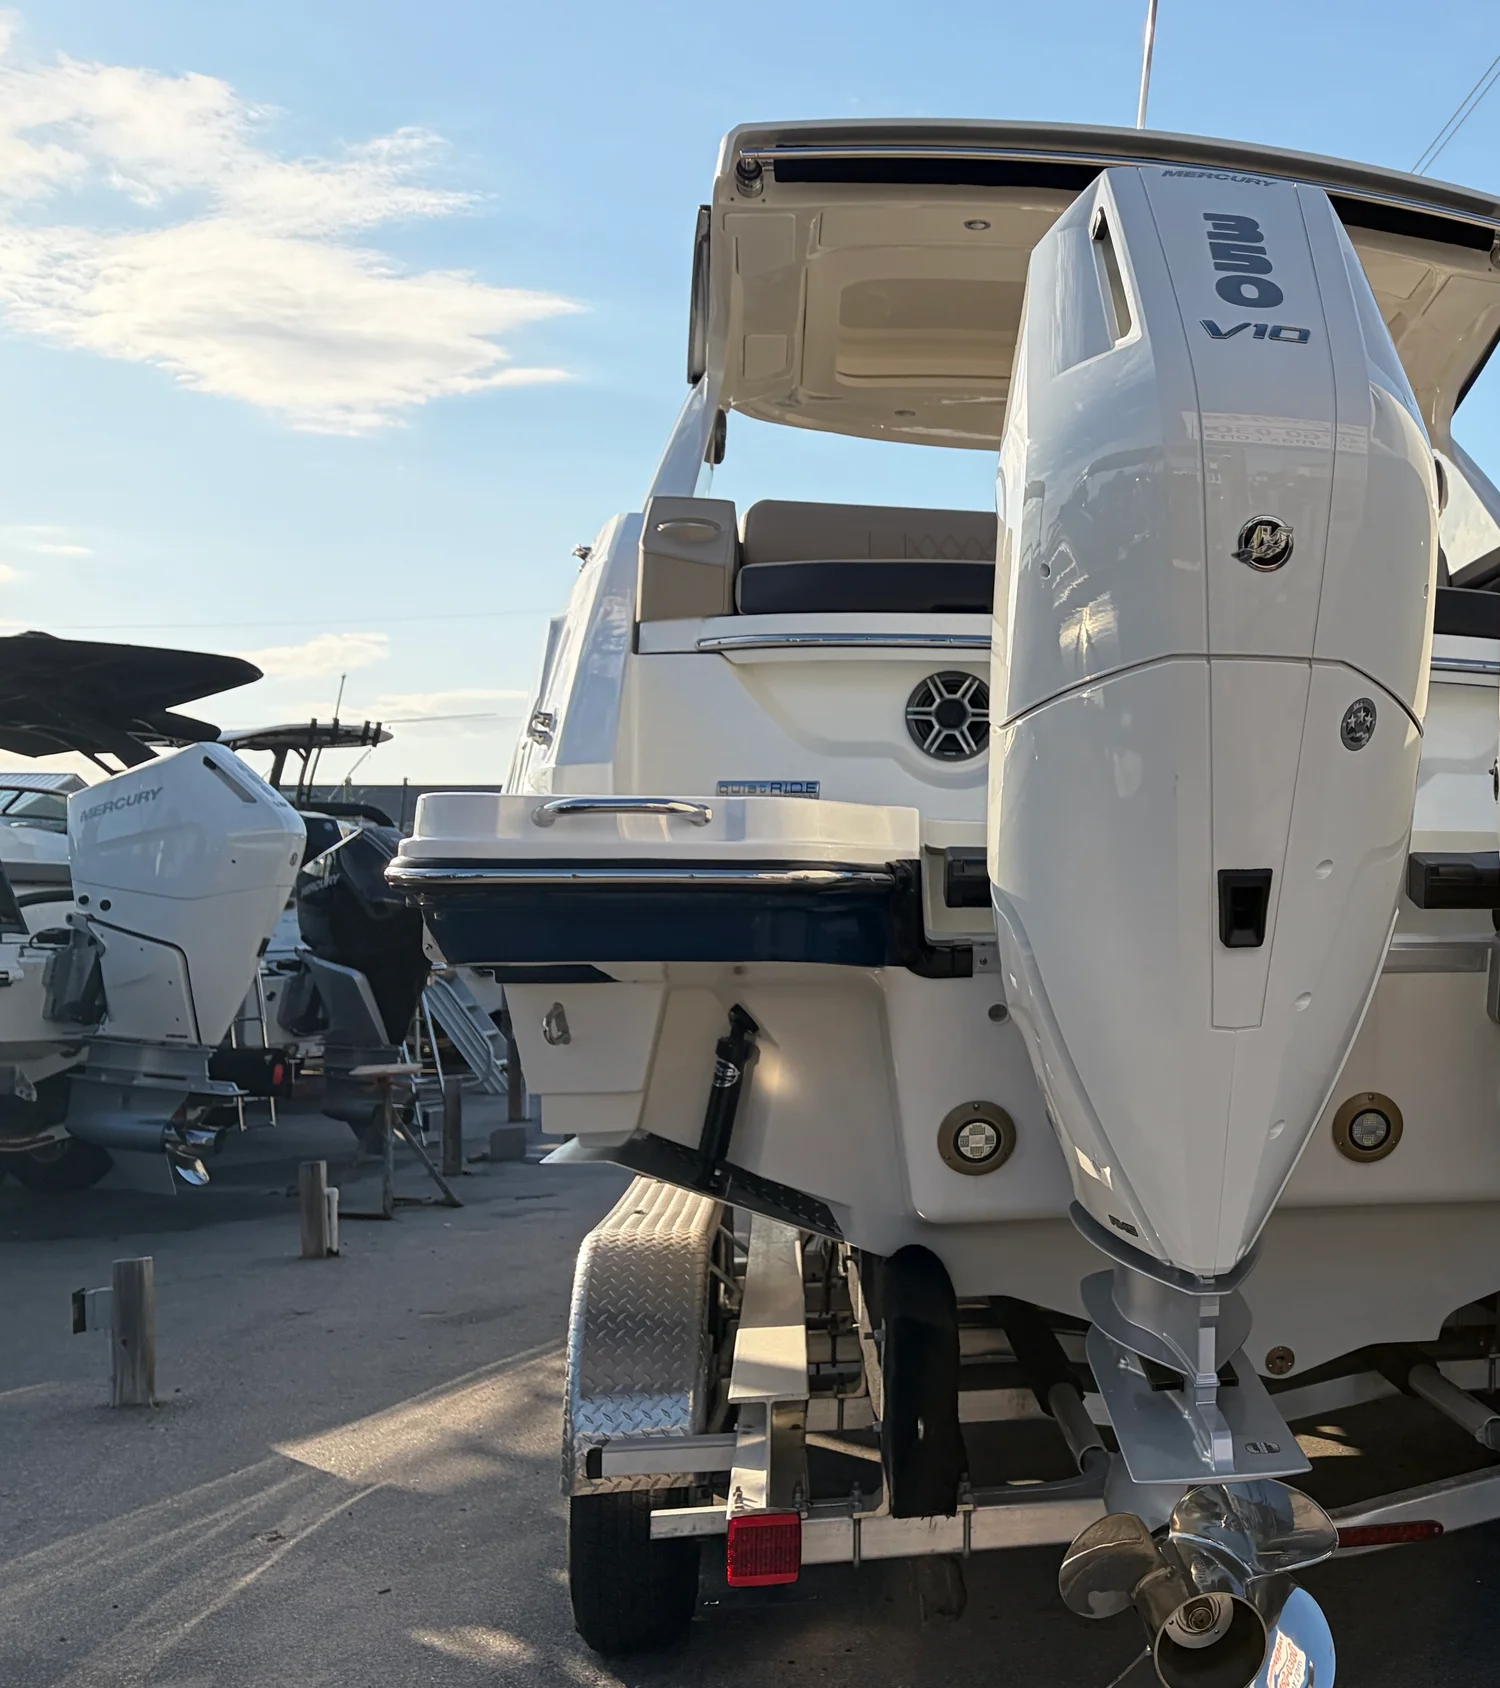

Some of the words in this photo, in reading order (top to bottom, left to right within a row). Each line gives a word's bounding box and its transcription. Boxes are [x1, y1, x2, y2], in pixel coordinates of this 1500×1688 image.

[1161, 169, 1278, 188] MERCURY
[1202, 212, 1284, 309] 350
[1199, 319, 1312, 344] V10
[80, 786, 164, 823] MERCURY
